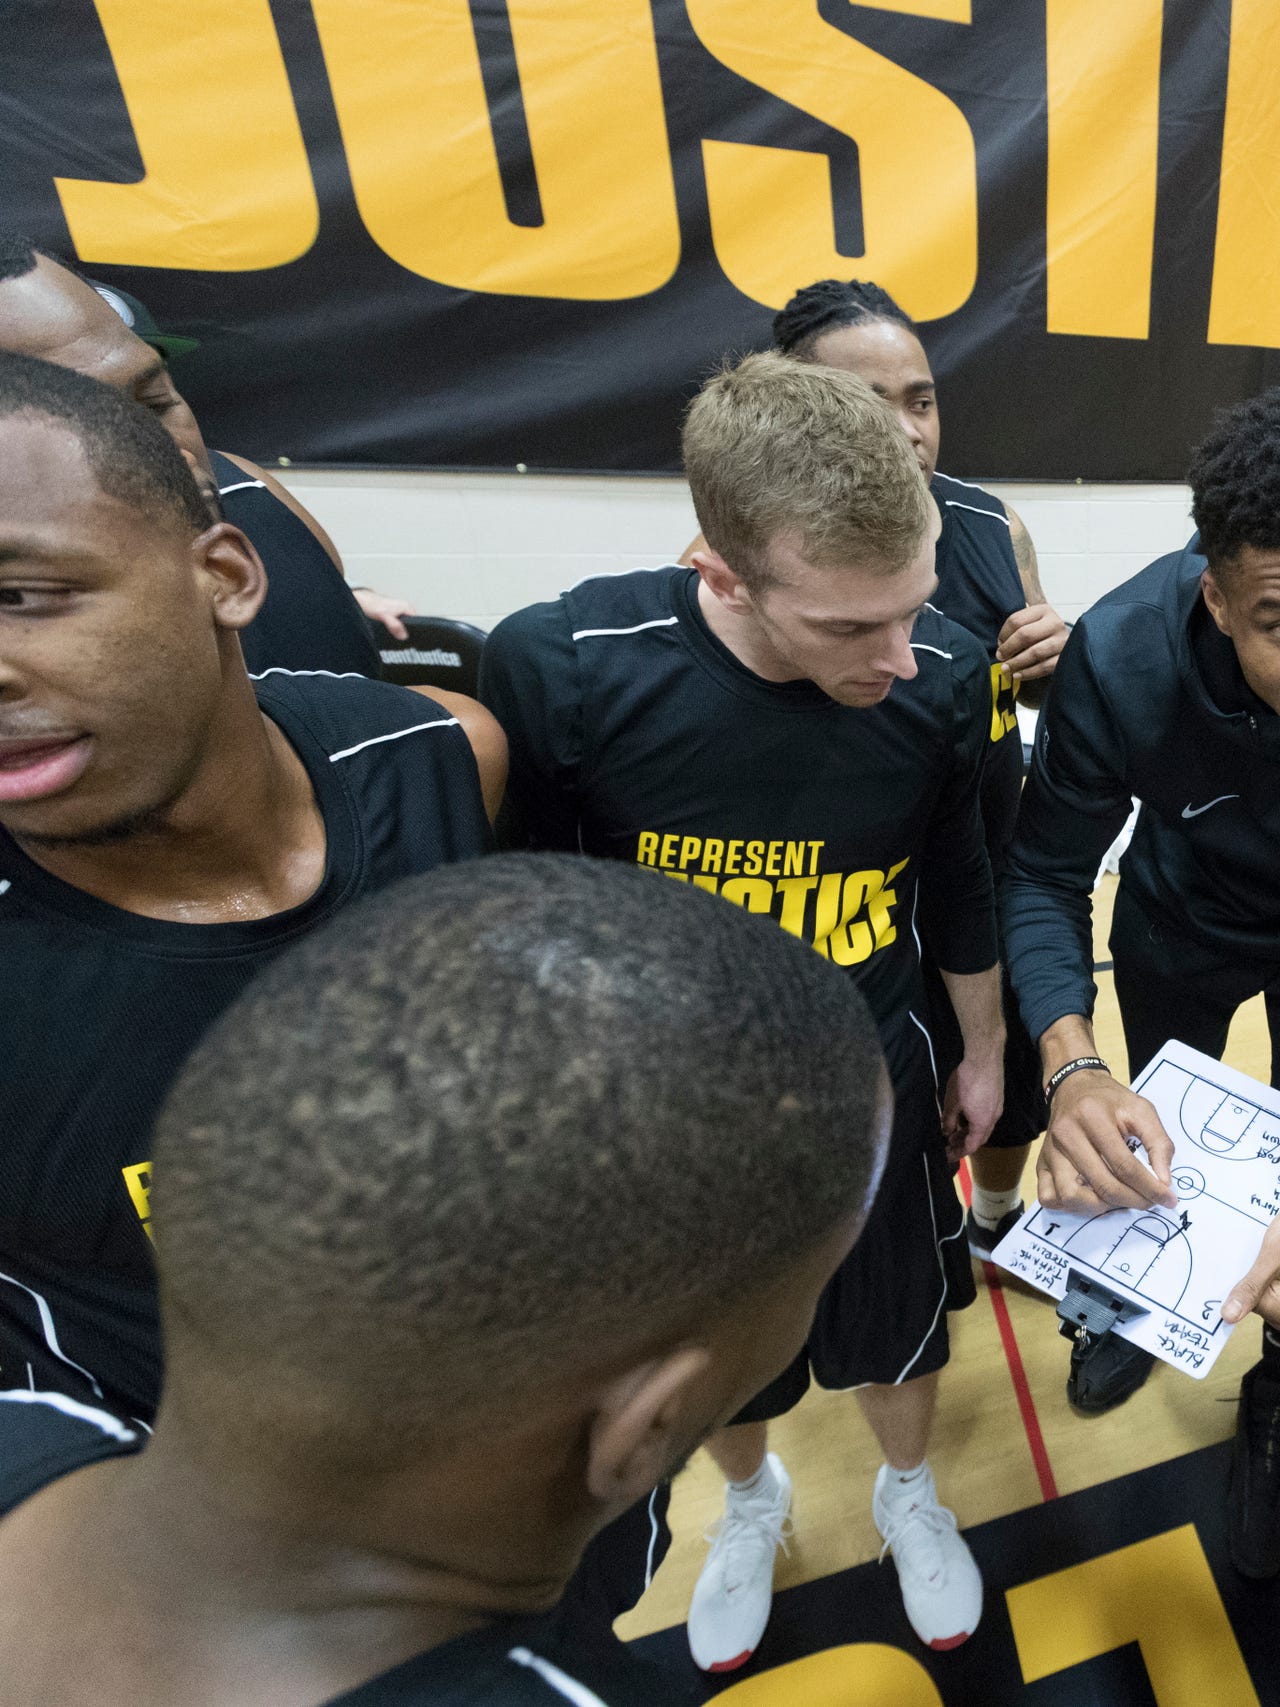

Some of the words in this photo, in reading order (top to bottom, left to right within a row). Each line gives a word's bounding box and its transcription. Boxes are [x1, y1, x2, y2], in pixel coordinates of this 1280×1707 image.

[636, 831, 825, 876] REPRESENT
[1051, 1062, 1076, 1085] Never
[1077, 1058, 1100, 1066] Give
[1157, 1333, 1205, 1368] BLACK
